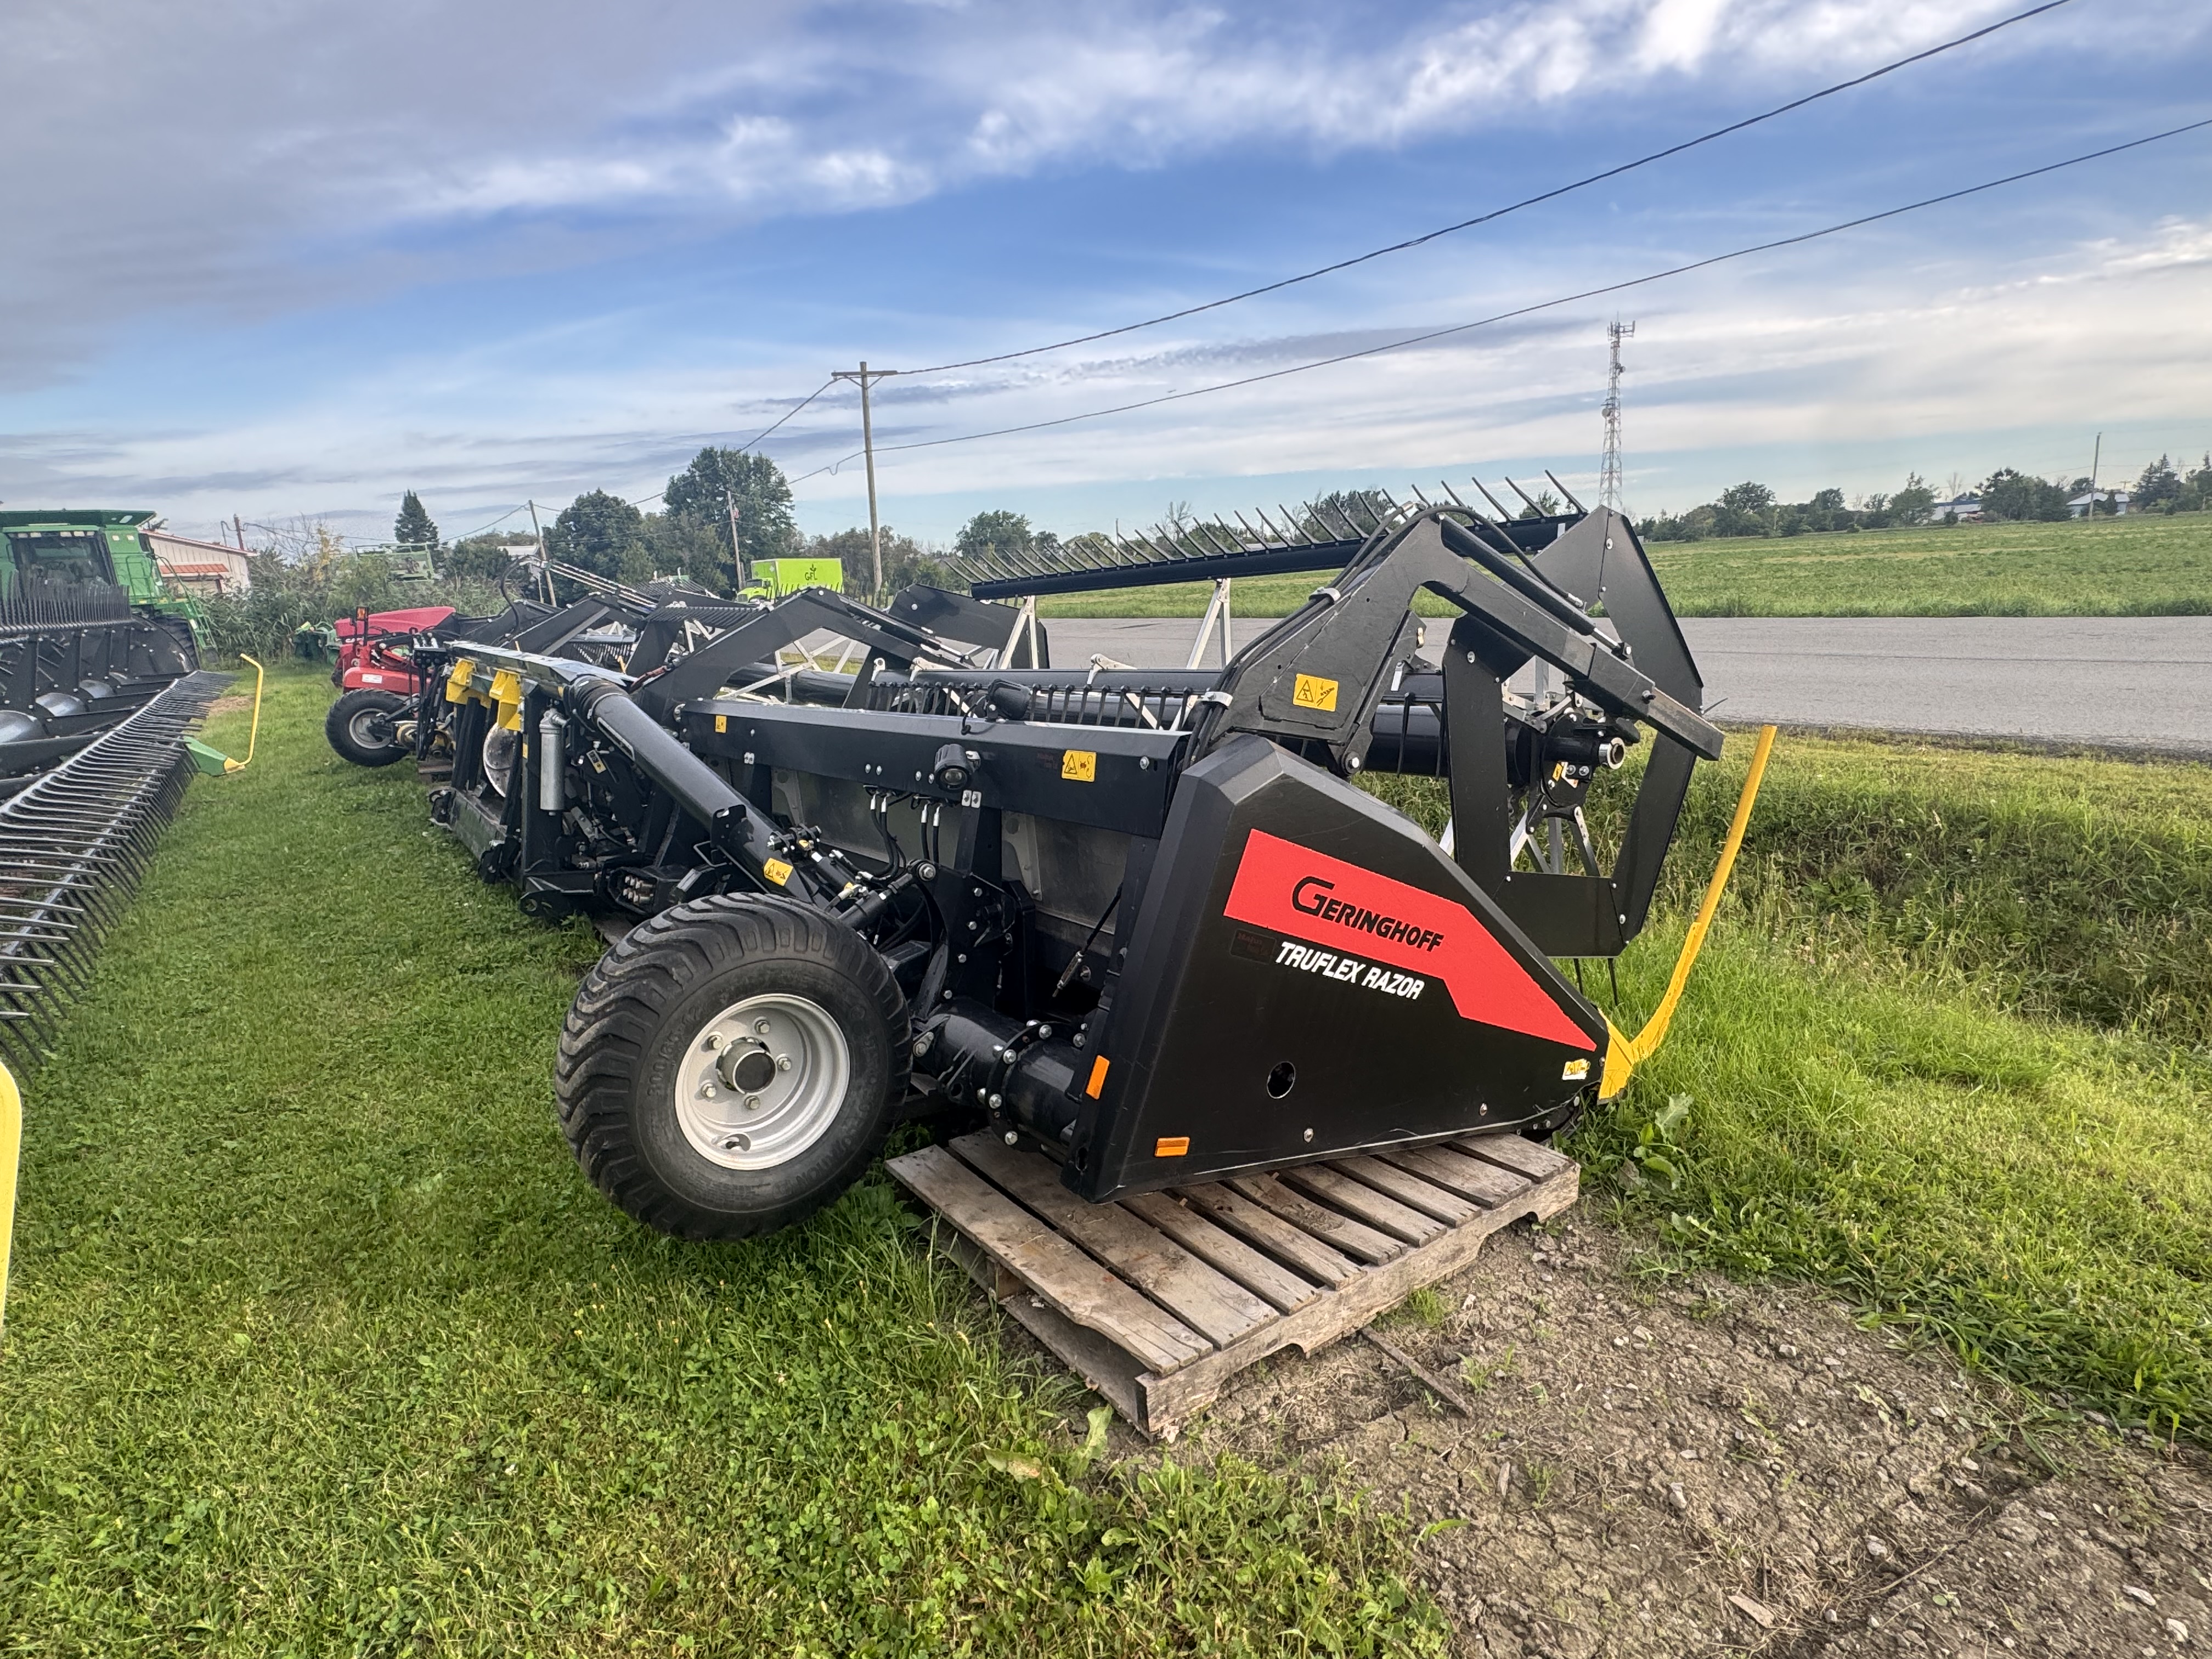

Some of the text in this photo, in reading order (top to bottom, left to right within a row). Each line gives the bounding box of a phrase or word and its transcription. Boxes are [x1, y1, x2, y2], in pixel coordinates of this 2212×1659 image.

[805, 571, 817, 580] GFL
[1276, 941, 1366, 983] TRUFLEX
[1362, 967, 1425, 1000] RAZOR
